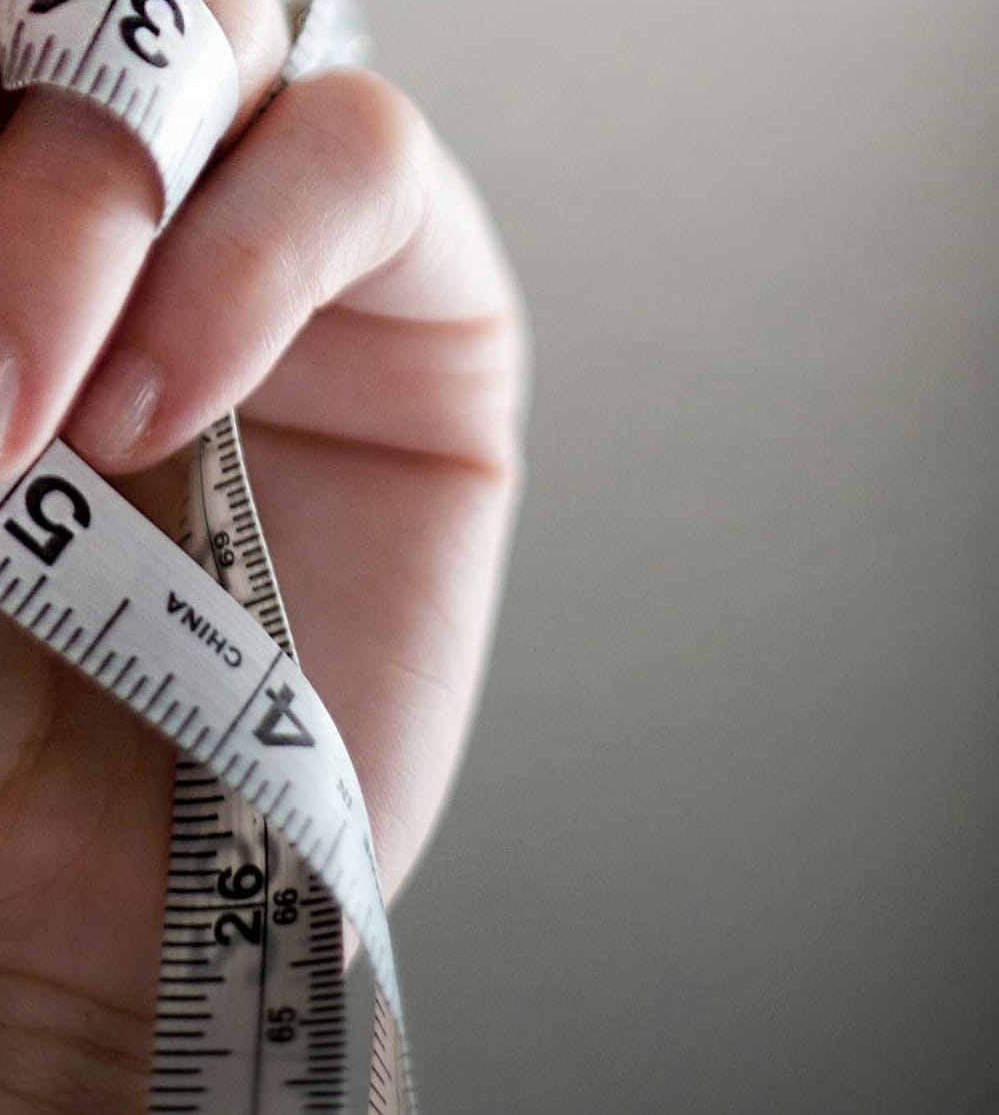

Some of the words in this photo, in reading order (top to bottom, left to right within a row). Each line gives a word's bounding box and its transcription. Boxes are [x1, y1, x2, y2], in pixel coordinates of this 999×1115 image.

[4, 474, 91, 566] 5
[214, 531, 234, 567] 69
[166, 590, 242, 668] CHINA
[252, 681, 316, 746] 4
[214, 863, 264, 946] 26
[272, 887, 299, 925] 66
[267, 1006, 297, 1044] 65
